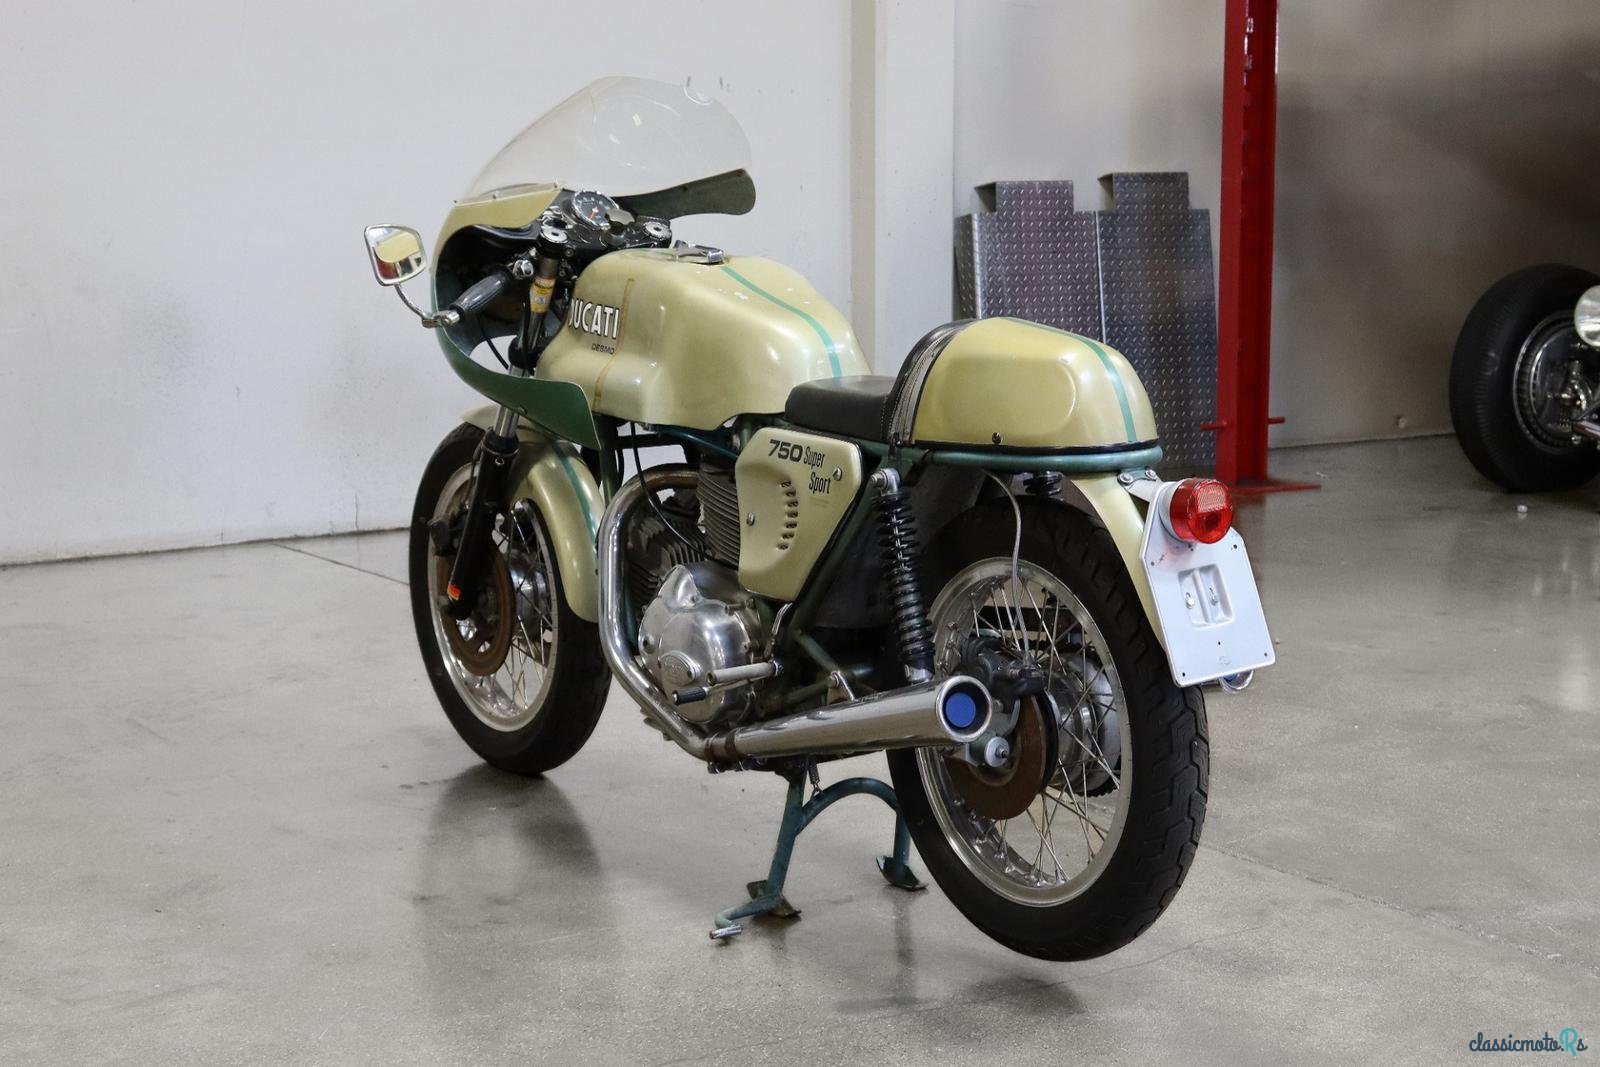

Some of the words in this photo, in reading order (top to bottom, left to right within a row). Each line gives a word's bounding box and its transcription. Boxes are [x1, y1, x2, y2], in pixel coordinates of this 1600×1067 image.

[768, 438, 803, 462] 750
[803, 446, 825, 469] Super
[808, 472, 831, 494] Sport
